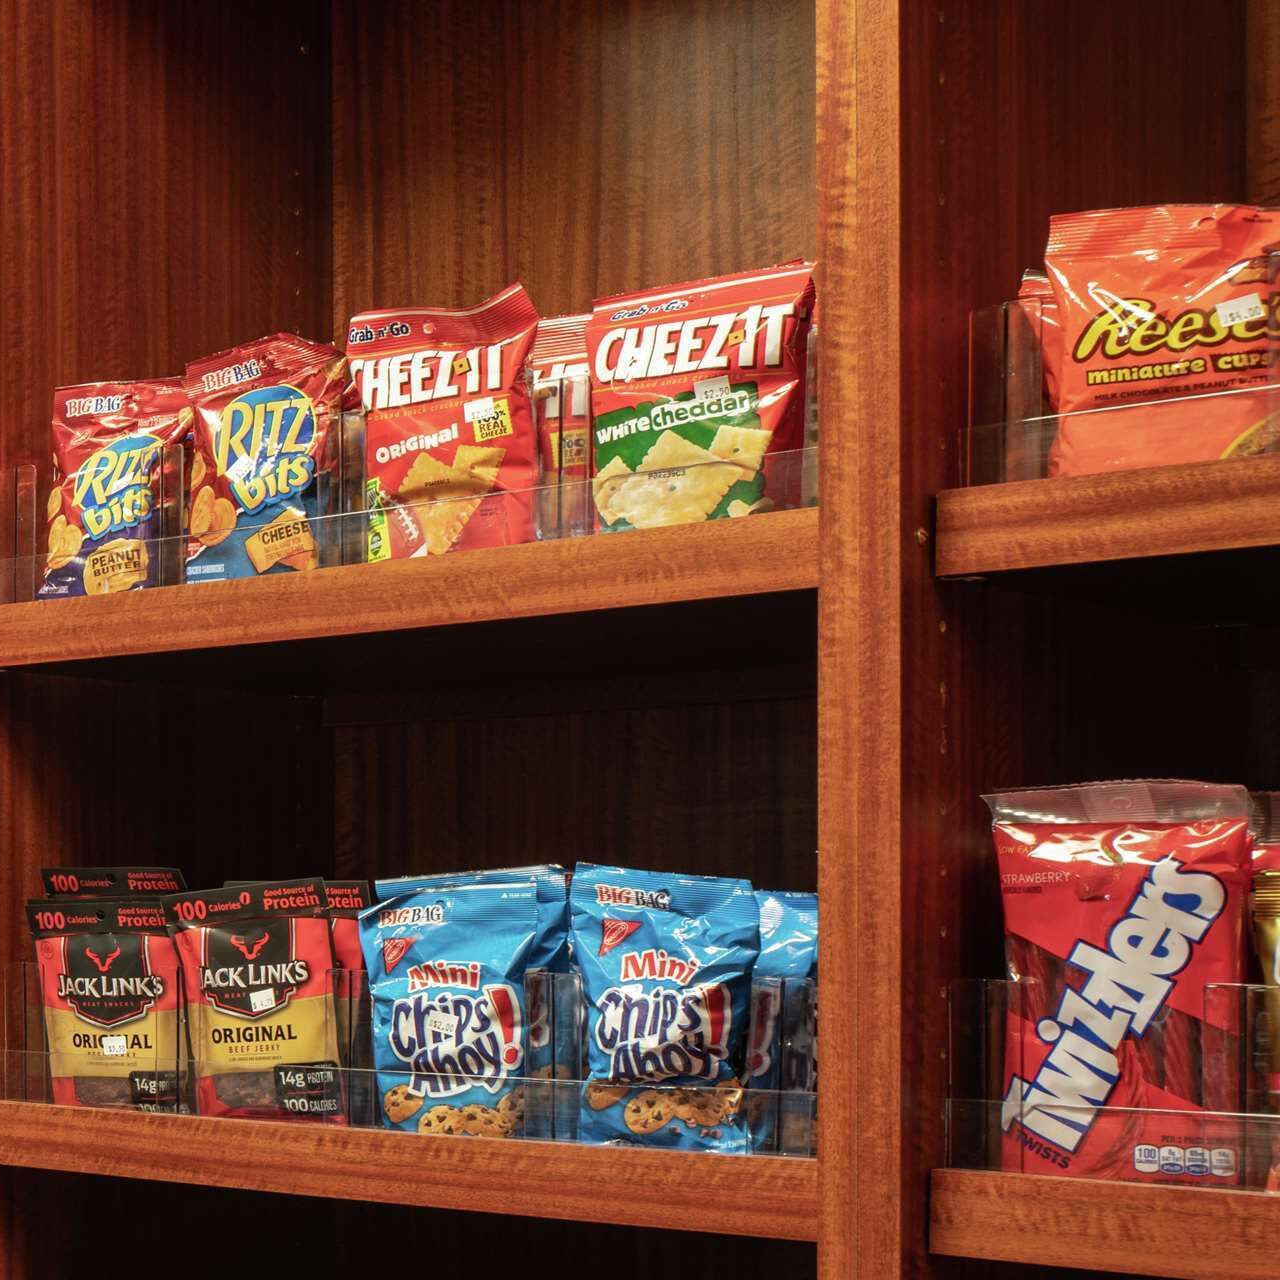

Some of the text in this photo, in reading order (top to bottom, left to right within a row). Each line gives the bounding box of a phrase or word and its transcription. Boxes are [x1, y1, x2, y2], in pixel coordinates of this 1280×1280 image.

[611, 300, 688, 321] Grab Go
[349, 323, 410, 344] Grab Go
[203, 361, 261, 392] BIG BAG
[1087, 357, 1204, 385] miniature
[1120, 386, 1182, 399] CHOCOLATE
[1192, 379, 1235, 391] PEANUT
[66, 395, 121, 417] BIG BAG
[479, 421, 505, 432] REAL
[596, 393, 749, 445] WHITE cheddar
[217, 398, 313, 476] RITZ
[377, 424, 459, 464] ORIGINAL
[480, 428, 509, 441] CHEESE
[233, 455, 311, 509] bits
[83, 487, 151, 533] bits
[262, 522, 309, 544] CHEESE
[92, 550, 140, 568] PEANUT
[94, 560, 140, 576] BUTTER
[51, 875, 109, 892] 100 Calories
[127, 879, 179, 891] Protein
[1002, 872, 1070, 884] STRAWBERRY
[263, 894, 319, 910] Protein
[264, 887, 306, 897] Good Source
[596, 884, 670, 910] BIG BAG
[36, 912, 97, 929] 100 Calories
[173, 901, 240, 921] 100 Calories
[380, 906, 444, 927] BIG BAG
[248, 960, 309, 985] LINK'S
[409, 961, 480, 992] Mini
[621, 951, 699, 985] Mini
[58, 975, 163, 997] JACK LINK'S
[1002, 850, 1228, 1153] Twizzlers
[596, 986, 702, 1052] Chips
[212, 1025, 297, 1044] ORIGINAL
[229, 1045, 281, 1053] BEEF JERKY
[136, 1078, 157, 1093] 14g
[279, 1072, 333, 1087] 14g PROTEIN
[284, 1098, 337, 1112] 100 CALORIES
[1017, 1127, 1072, 1170] TWISTS
